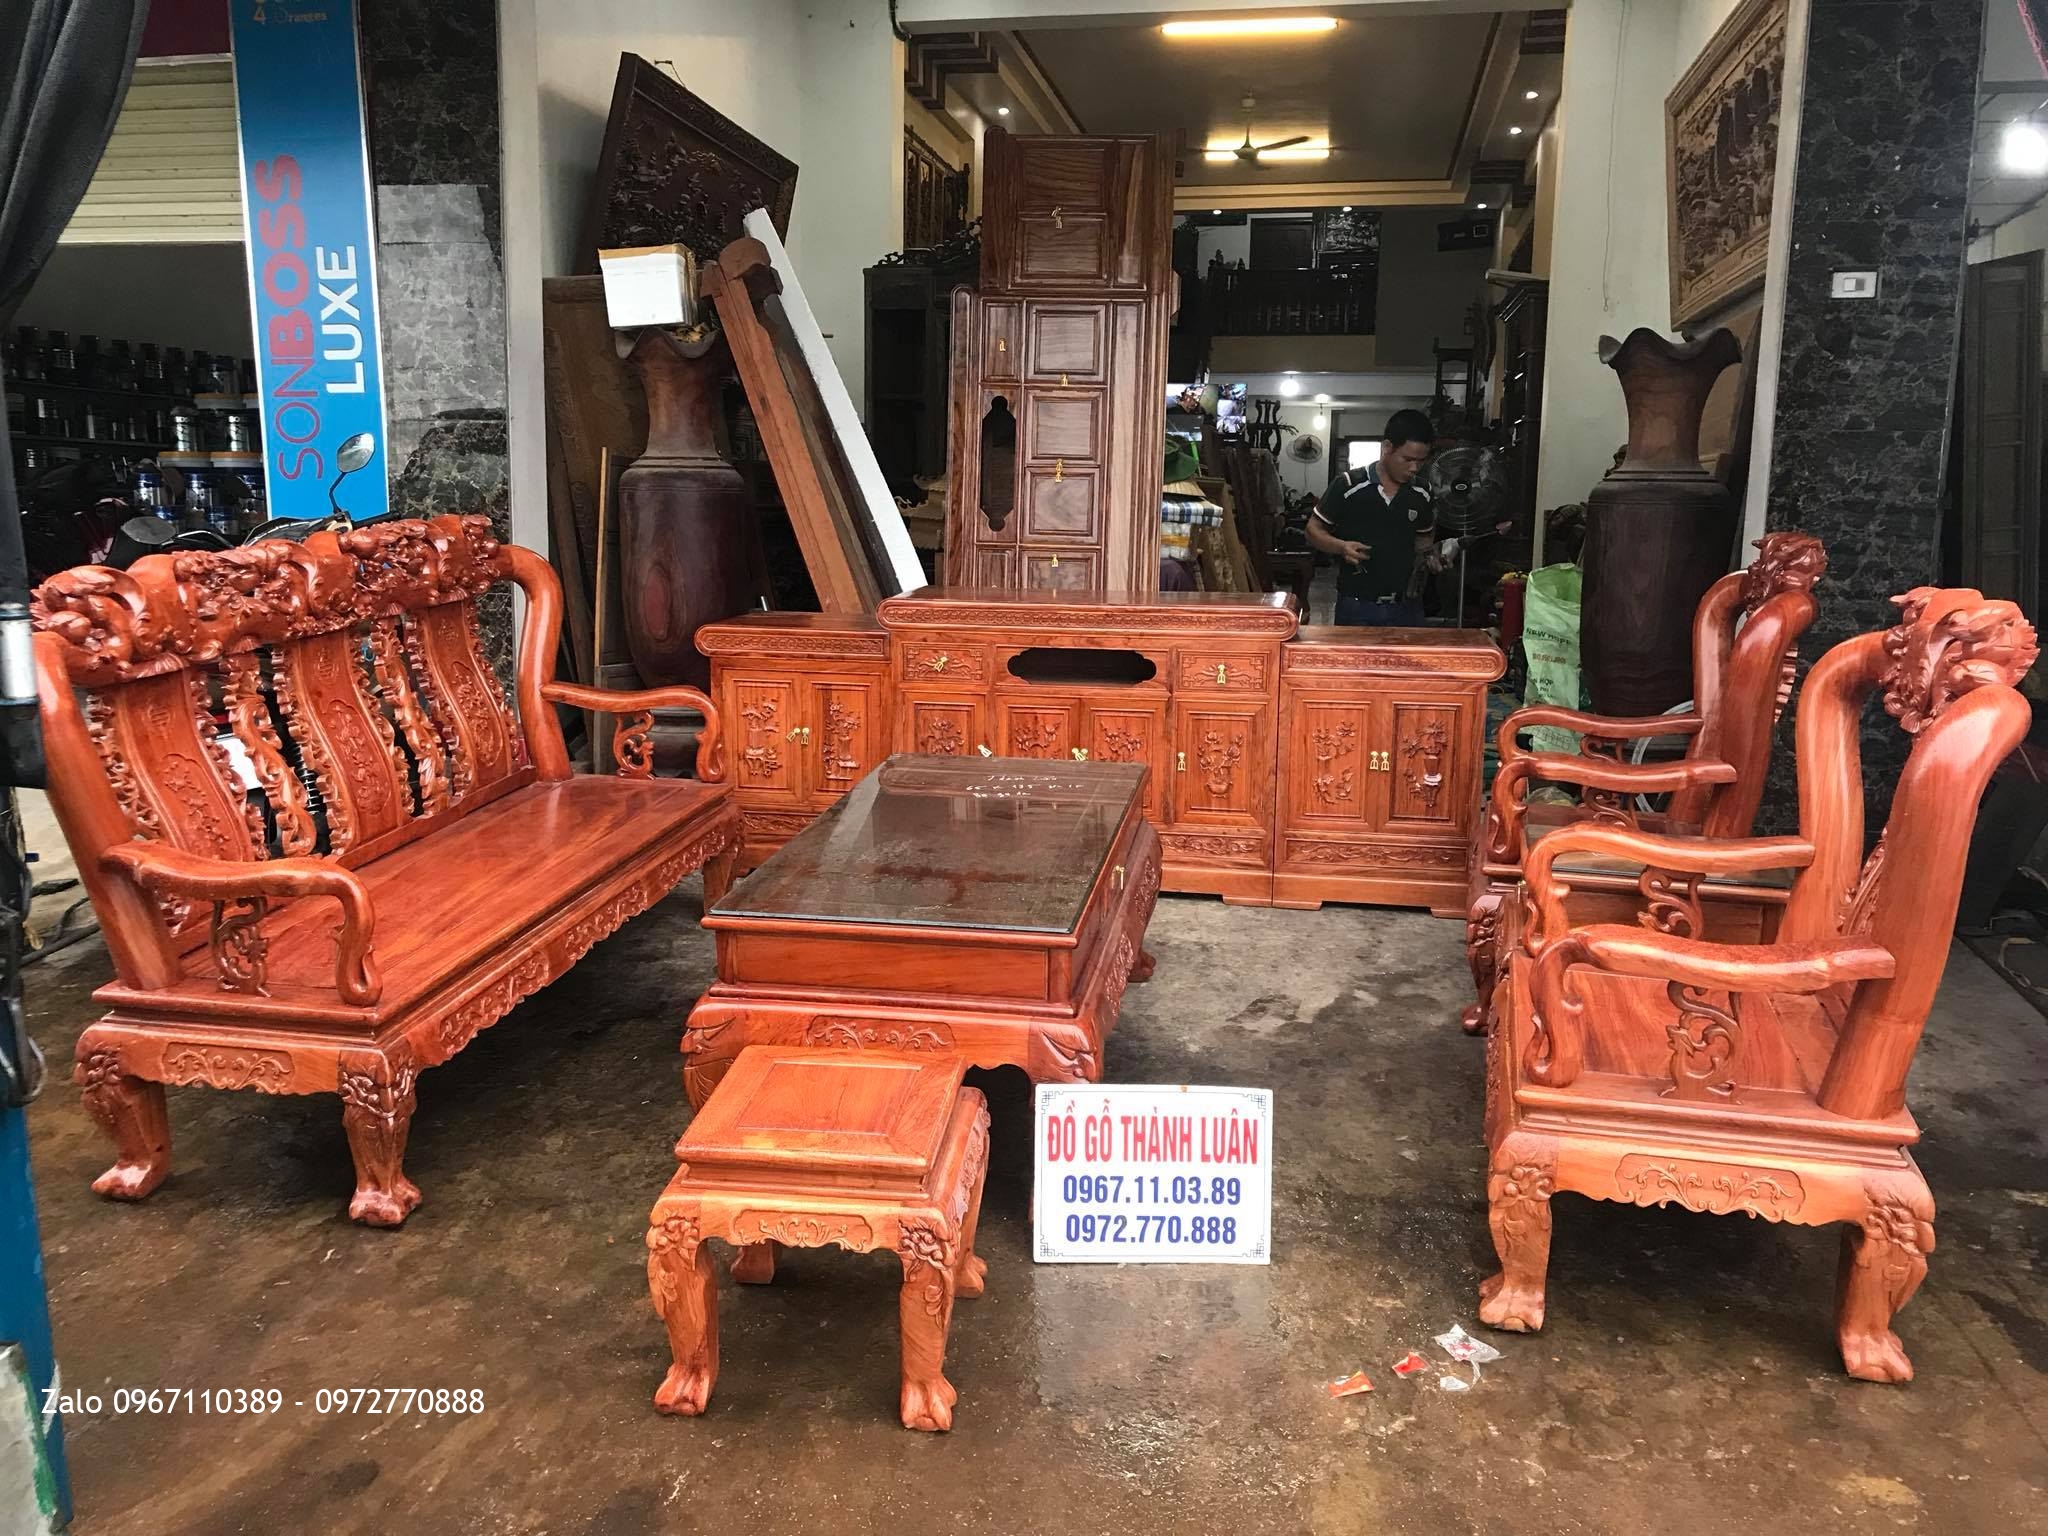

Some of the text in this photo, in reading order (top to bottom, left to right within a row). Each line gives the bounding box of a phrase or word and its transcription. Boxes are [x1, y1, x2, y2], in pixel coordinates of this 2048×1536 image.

[254, 154, 324, 481] SONBOSS
[316, 245, 366, 394] LUXE
[1047, 1098, 1258, 1164] ĐỒ GỖ THÀNH LUÂN
[1063, 1174, 1242, 1205] 0967.11.03.89
[1065, 1214, 1237, 1245] 0972.770.888
